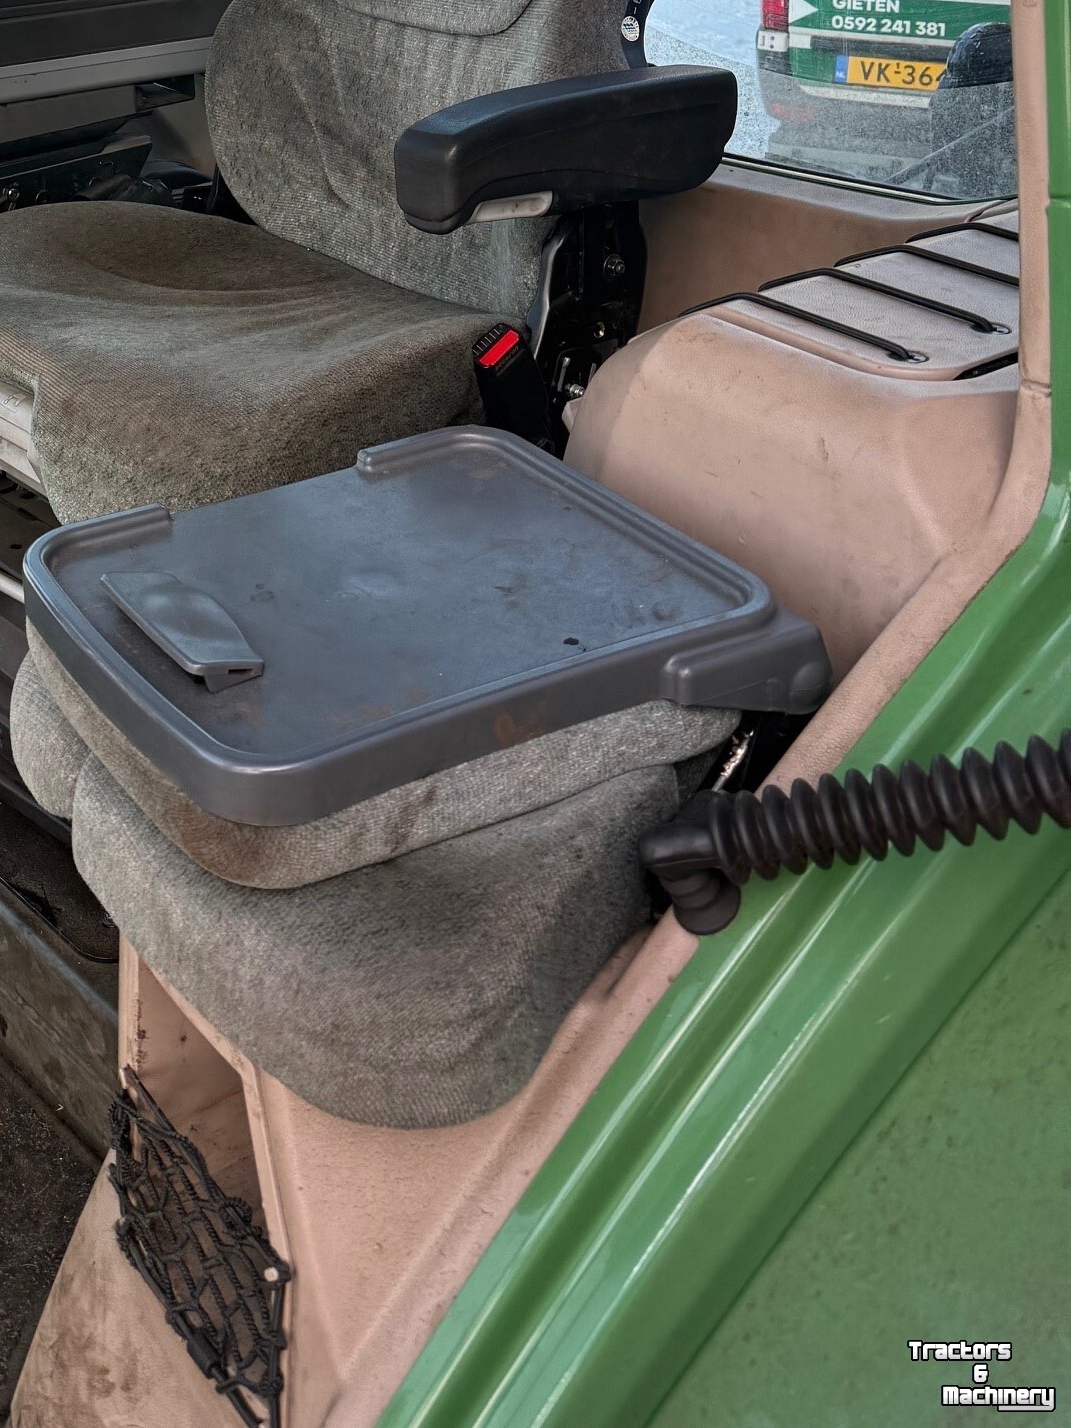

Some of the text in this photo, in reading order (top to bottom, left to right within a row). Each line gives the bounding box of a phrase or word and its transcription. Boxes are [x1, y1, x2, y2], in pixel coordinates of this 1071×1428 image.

[831, 15, 946, 37] 0592 241 381
